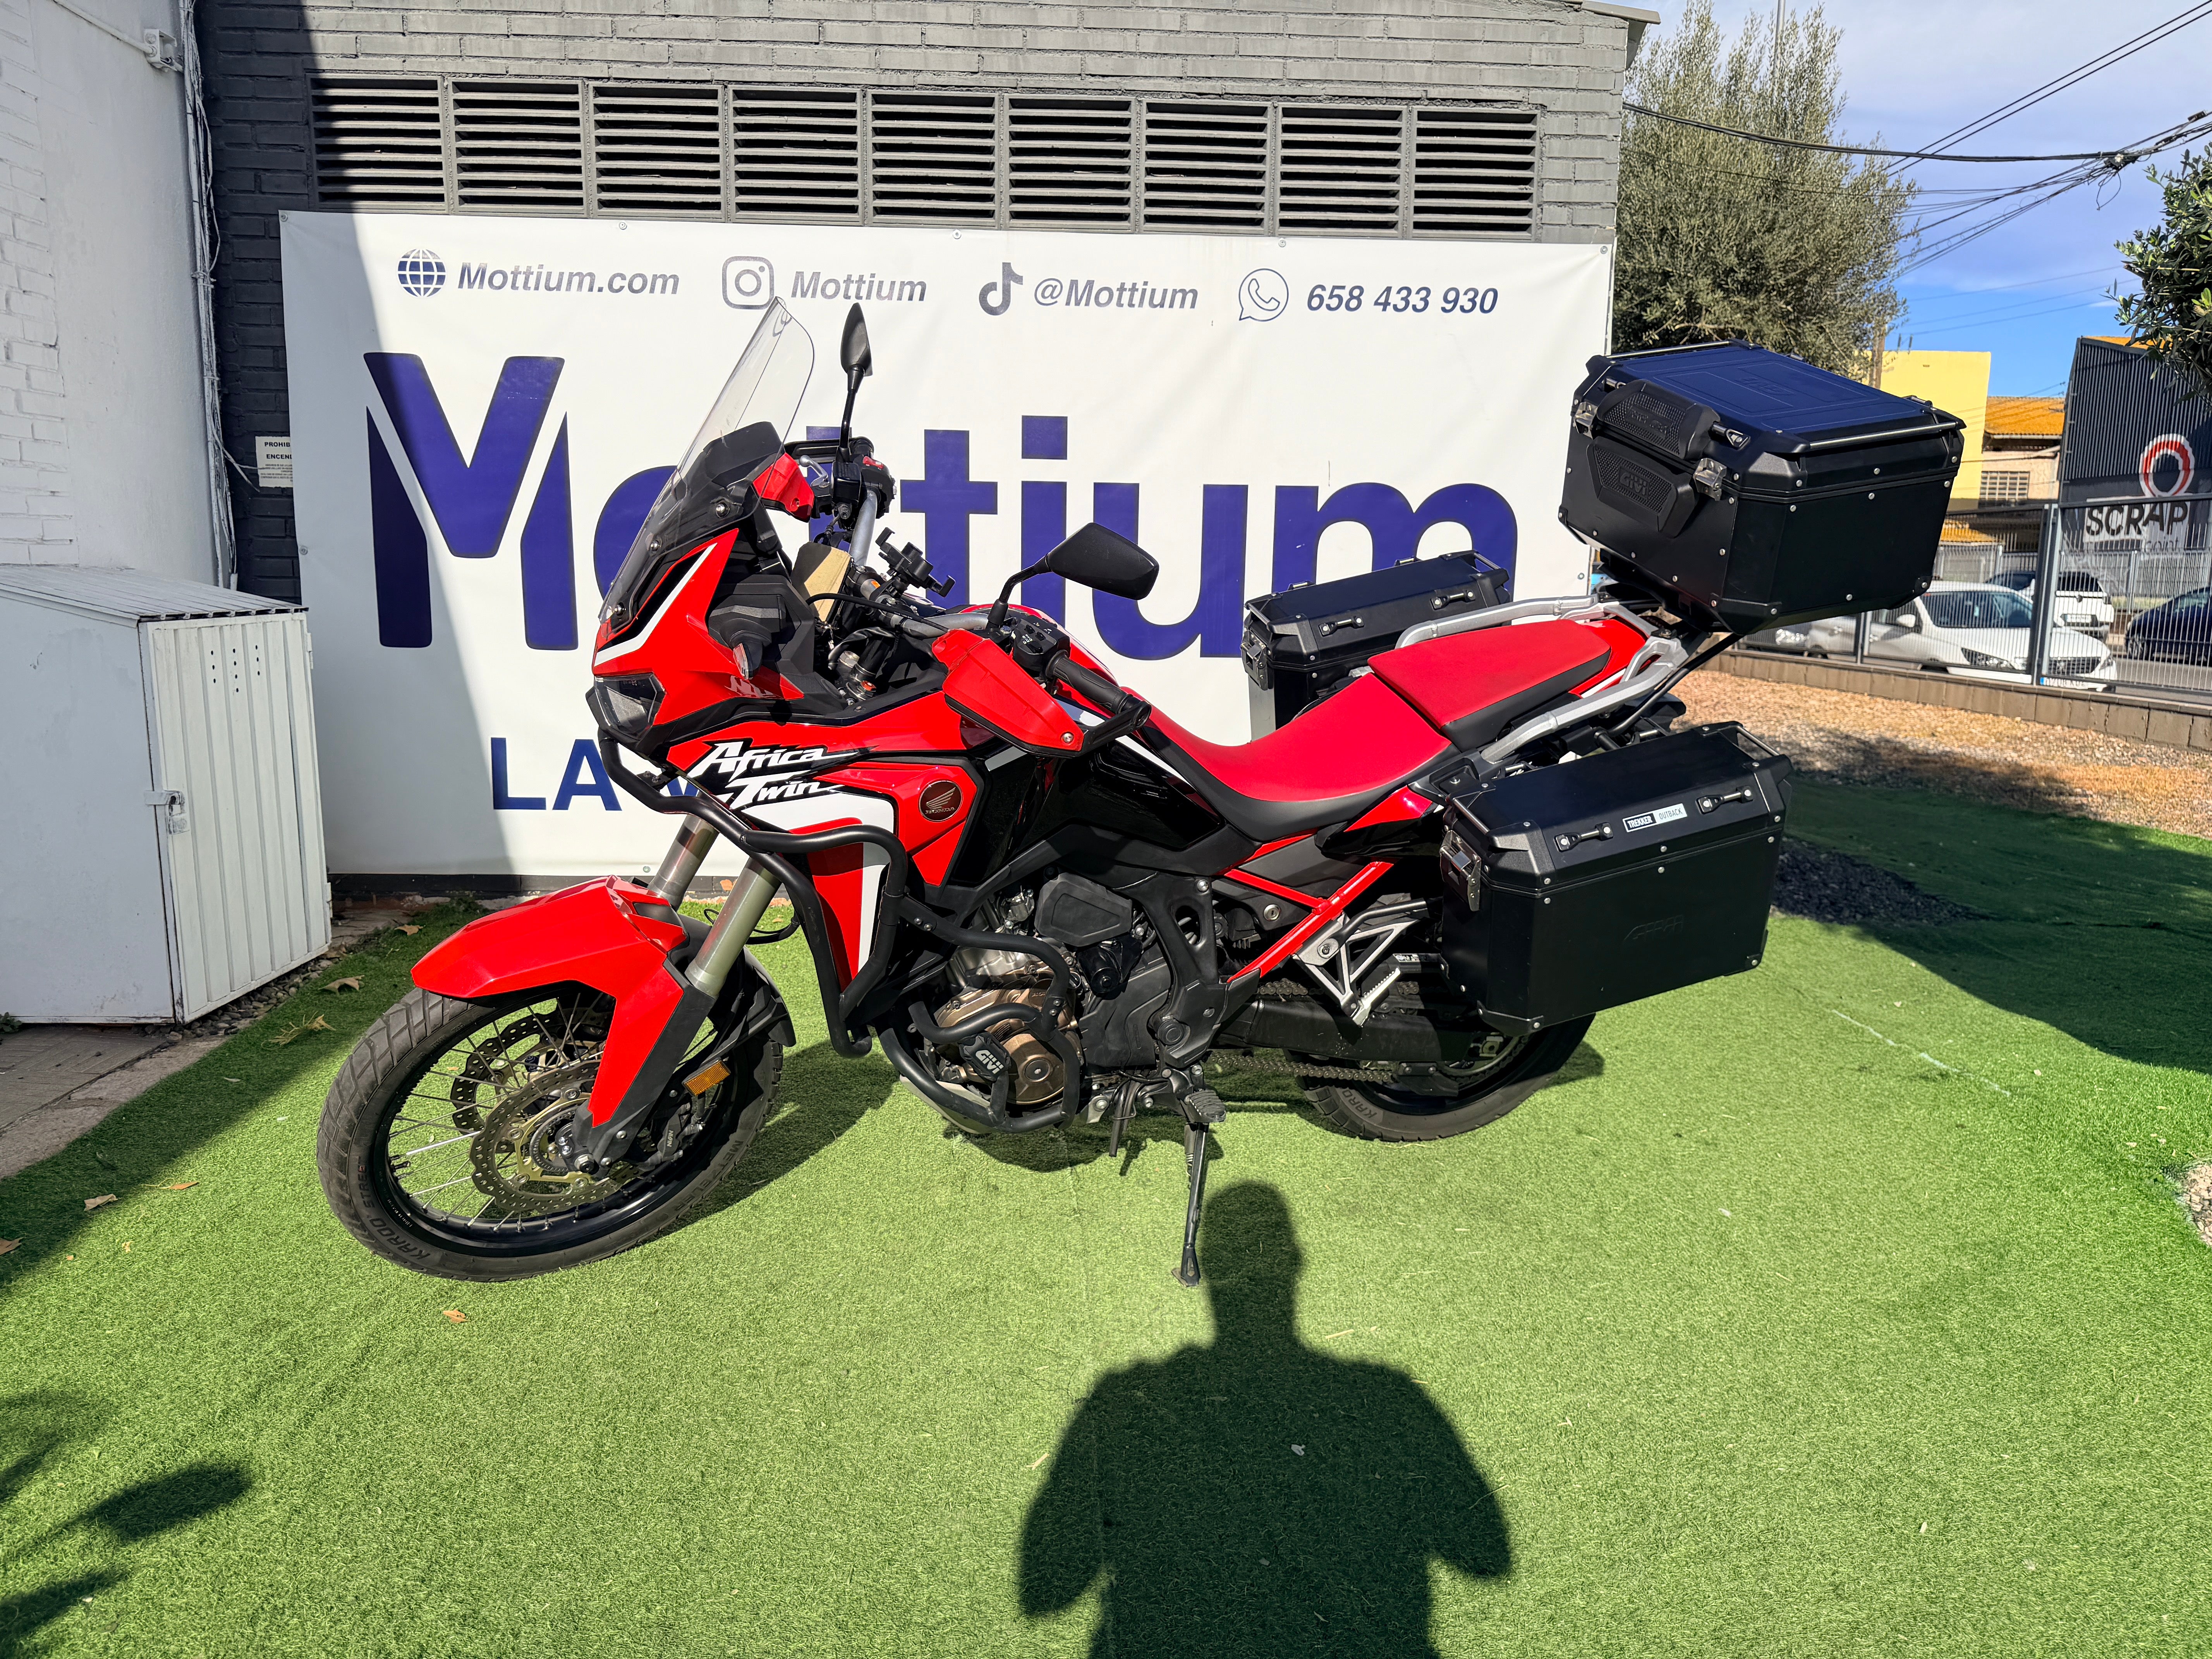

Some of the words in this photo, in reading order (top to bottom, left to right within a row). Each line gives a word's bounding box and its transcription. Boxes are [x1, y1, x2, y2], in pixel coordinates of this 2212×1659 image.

[457, 262, 680, 295] Mottium.com
[791, 271, 927, 301] Mottium
[1034, 278, 1198, 309] @Mottium
[1307, 284, 1364, 311] 658
[1374, 286, 1431, 313] 433
[1440, 287, 1498, 314] 930
[2086, 500, 2188, 536] SCRAP
[686, 741, 859, 780] Africa
[723, 769, 845, 810] Twin
[1627, 816, 1653, 828] TREKKER
[1659, 807, 1683, 820] OUTBACK
[369, 1218, 431, 1259] KAROO
